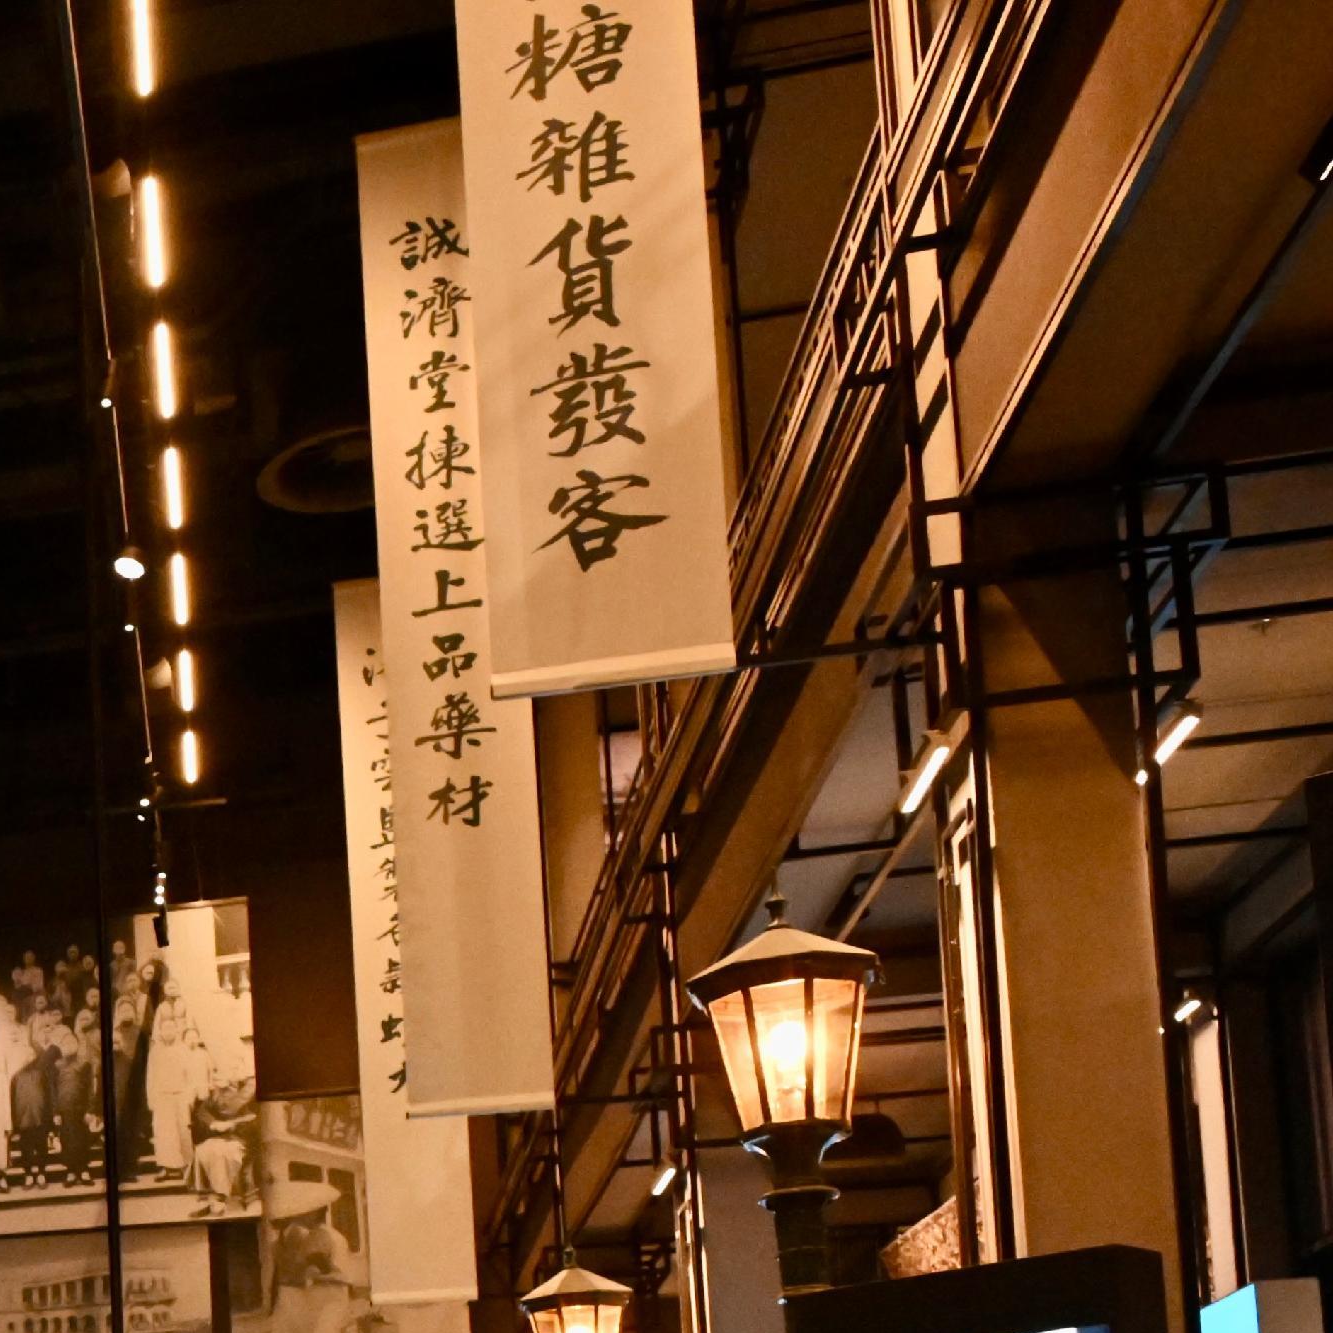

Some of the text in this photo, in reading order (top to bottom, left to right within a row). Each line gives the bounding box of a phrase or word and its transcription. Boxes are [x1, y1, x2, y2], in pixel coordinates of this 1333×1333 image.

[505, 3, 669, 573] 糖雜貨發客
